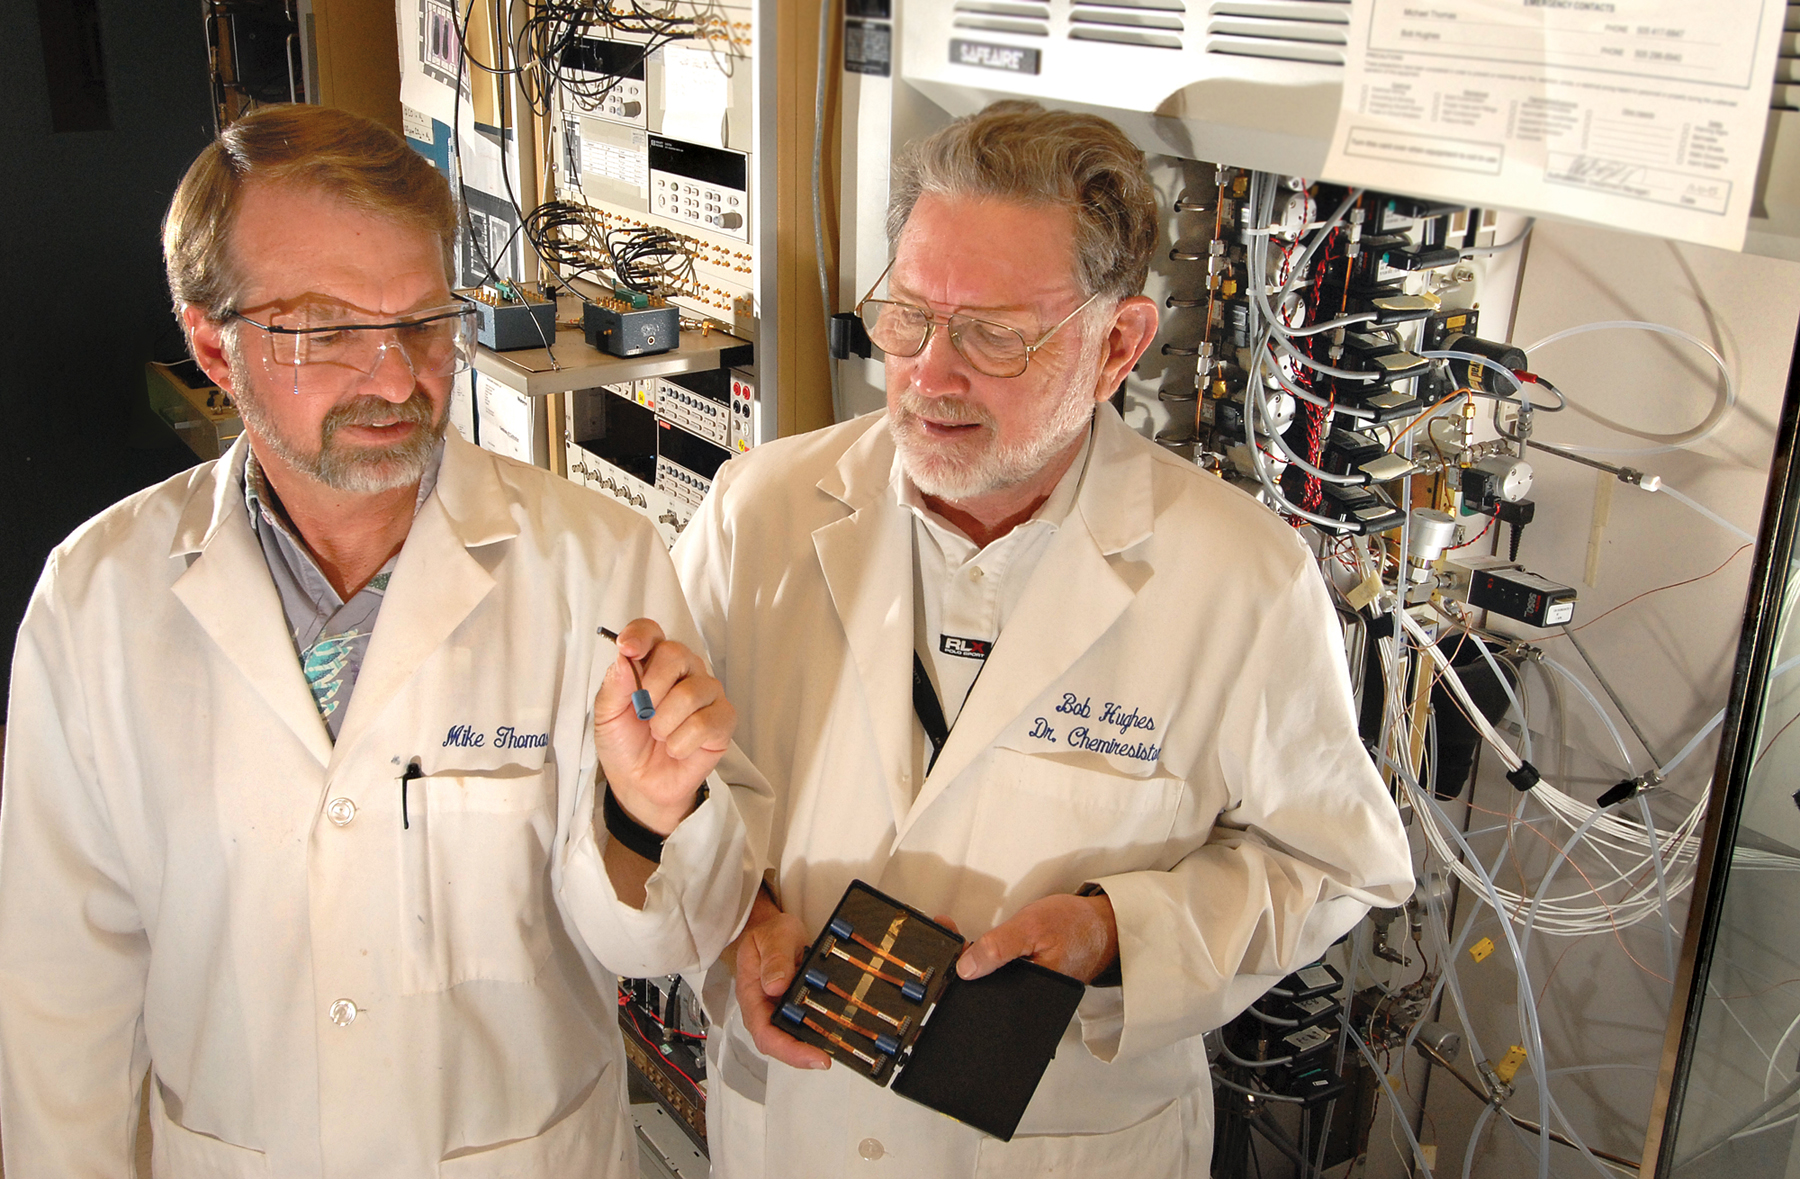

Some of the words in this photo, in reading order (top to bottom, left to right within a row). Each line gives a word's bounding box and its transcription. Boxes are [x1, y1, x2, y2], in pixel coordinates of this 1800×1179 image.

[945, 638, 985, 654] RLX
[1056, 692, 1090, 719] Bob
[1098, 702, 1155, 735] Hughes
[442, 725, 485, 747] Mike
[1029, 717, 1057, 743] Dr.
